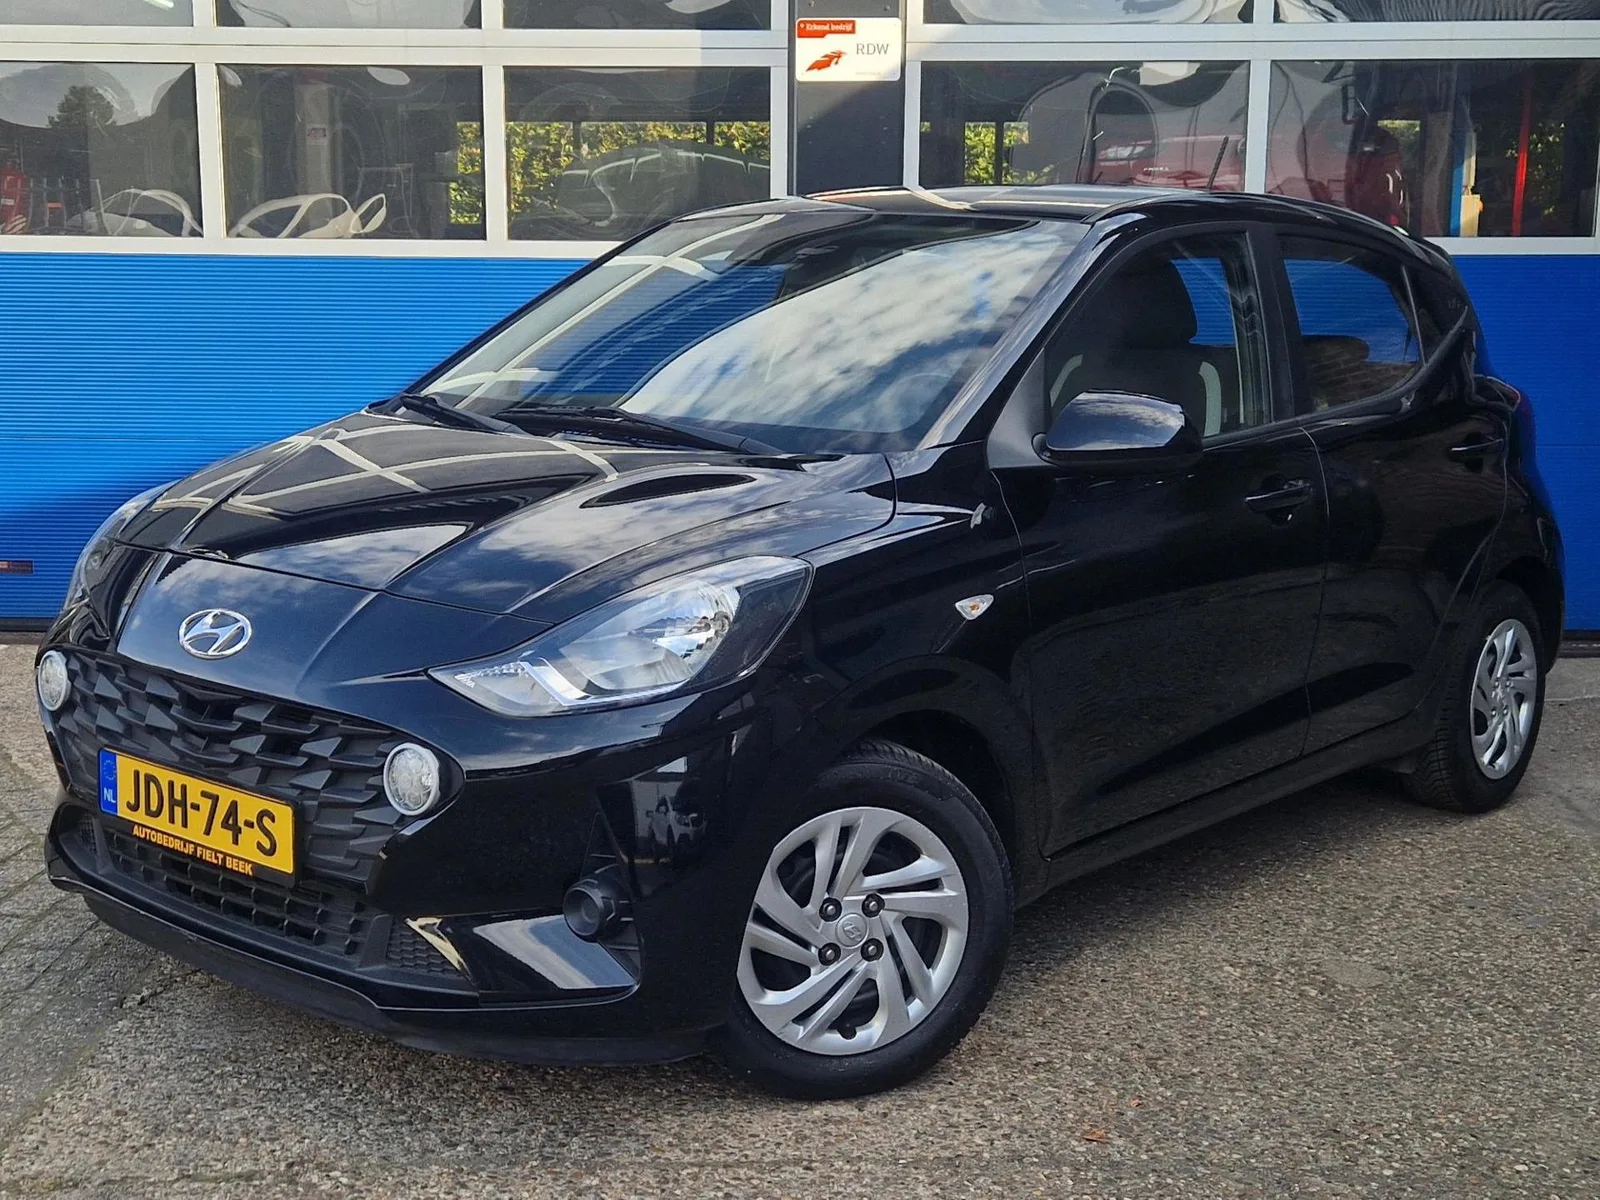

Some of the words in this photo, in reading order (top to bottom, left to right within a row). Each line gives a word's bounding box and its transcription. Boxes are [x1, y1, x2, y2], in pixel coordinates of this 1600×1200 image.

[806, 23, 830, 31] Erkend
[831, 22, 853, 32] bedrijf
[856, 43, 889, 55] RDW
[104, 787, 116, 802] NL
[126, 769, 278, 857] JDH-74-S
[132, 825, 195, 856] AUTOBEDRIJF
[196, 846, 223, 866] FIELT
[226, 856, 253, 876] BEEK
